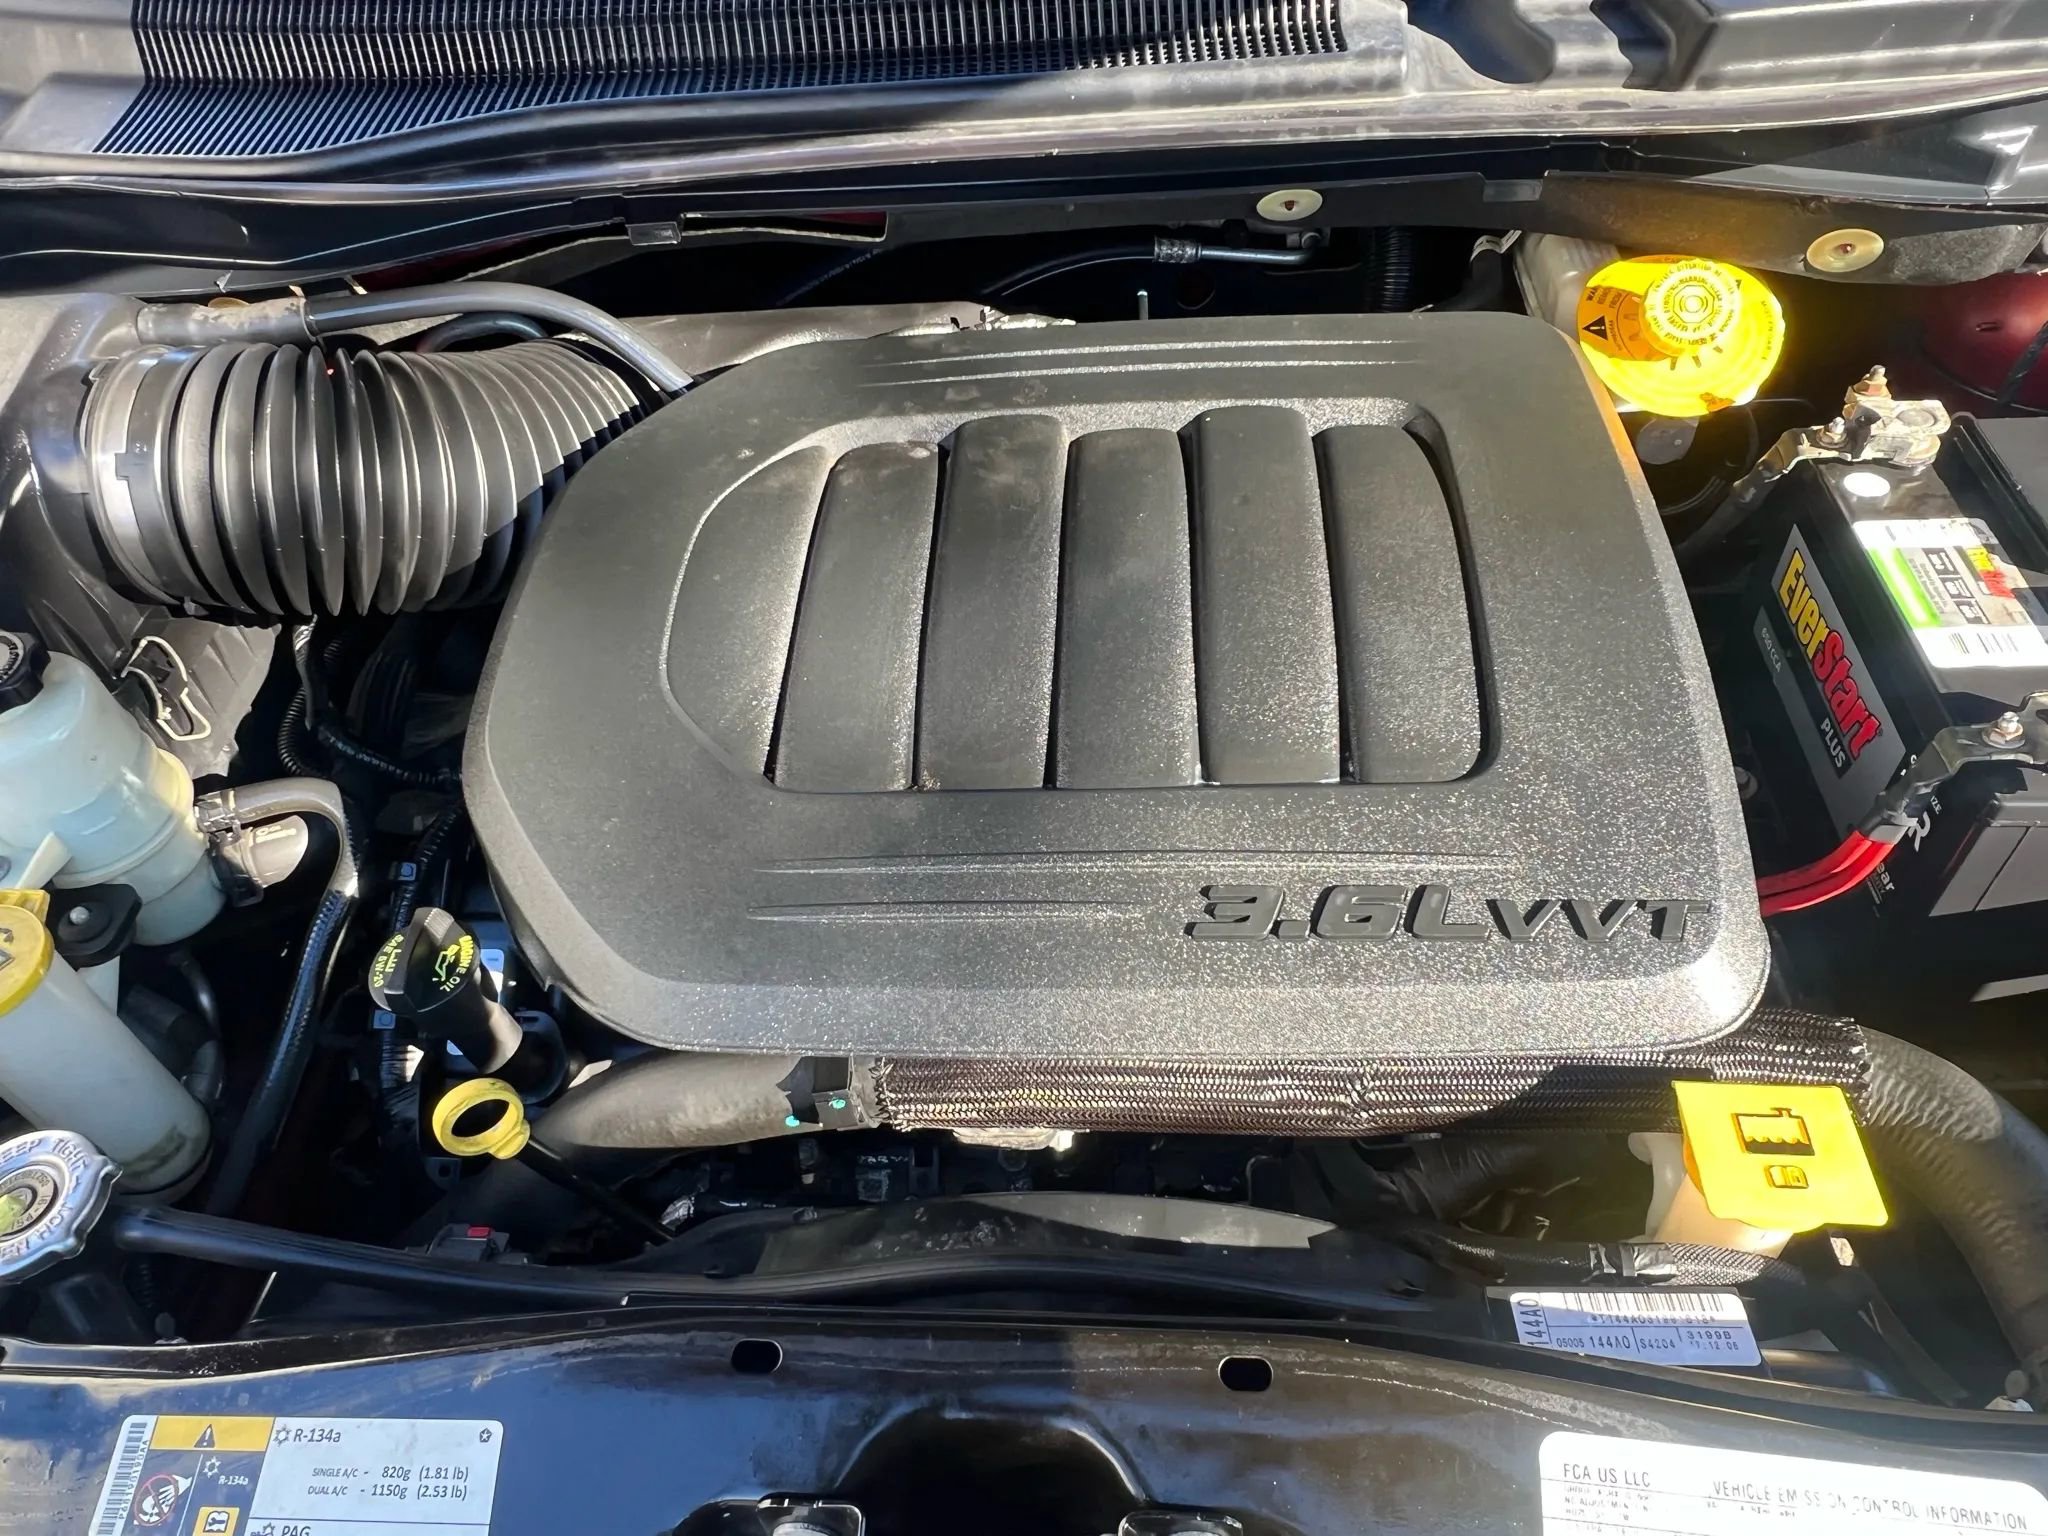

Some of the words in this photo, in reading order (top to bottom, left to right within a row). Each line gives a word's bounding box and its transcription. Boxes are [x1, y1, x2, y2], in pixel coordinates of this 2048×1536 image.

[1779, 549, 1881, 761] EverStart
[1820, 717, 1846, 768] PLUS
[1875, 863, 1895, 891] ear
[455, 935, 474, 975] ENGINE
[439, 976, 461, 992] OIL
[0, 1138, 42, 1167] EEP
[51, 1137, 90, 1172] TIGHT
[1639, 1337, 1676, 1349] S4204
[292, 1428, 342, 1443] R-134a
[218, 1475, 249, 1486] R-134a
[312, 1467, 342, 1477] SINGLE
[342, 1467, 359, 1479] A/C
[382, 1466, 411, 1482] 820g
[419, 1465, 449, 1482] (1.81
[452, 1466, 469, 1483] lb)
[1563, 1463, 1592, 1481] FCA
[1598, 1467, 1618, 1484] US
[1624, 1470, 1651, 1488] LLC
[307, 1485, 330, 1495] DUAL
[331, 1485, 348, 1496] A/C
[371, 1484, 408, 1499] 1150g
[417, 1485, 447, 1500] (2.53
[450, 1484, 468, 1501] lb)
[1713, 1480, 1772, 1501] VEHICLE
[1778, 1487, 1846, 1509] EMSSON
[282, 1525, 311, 1536] PAG
